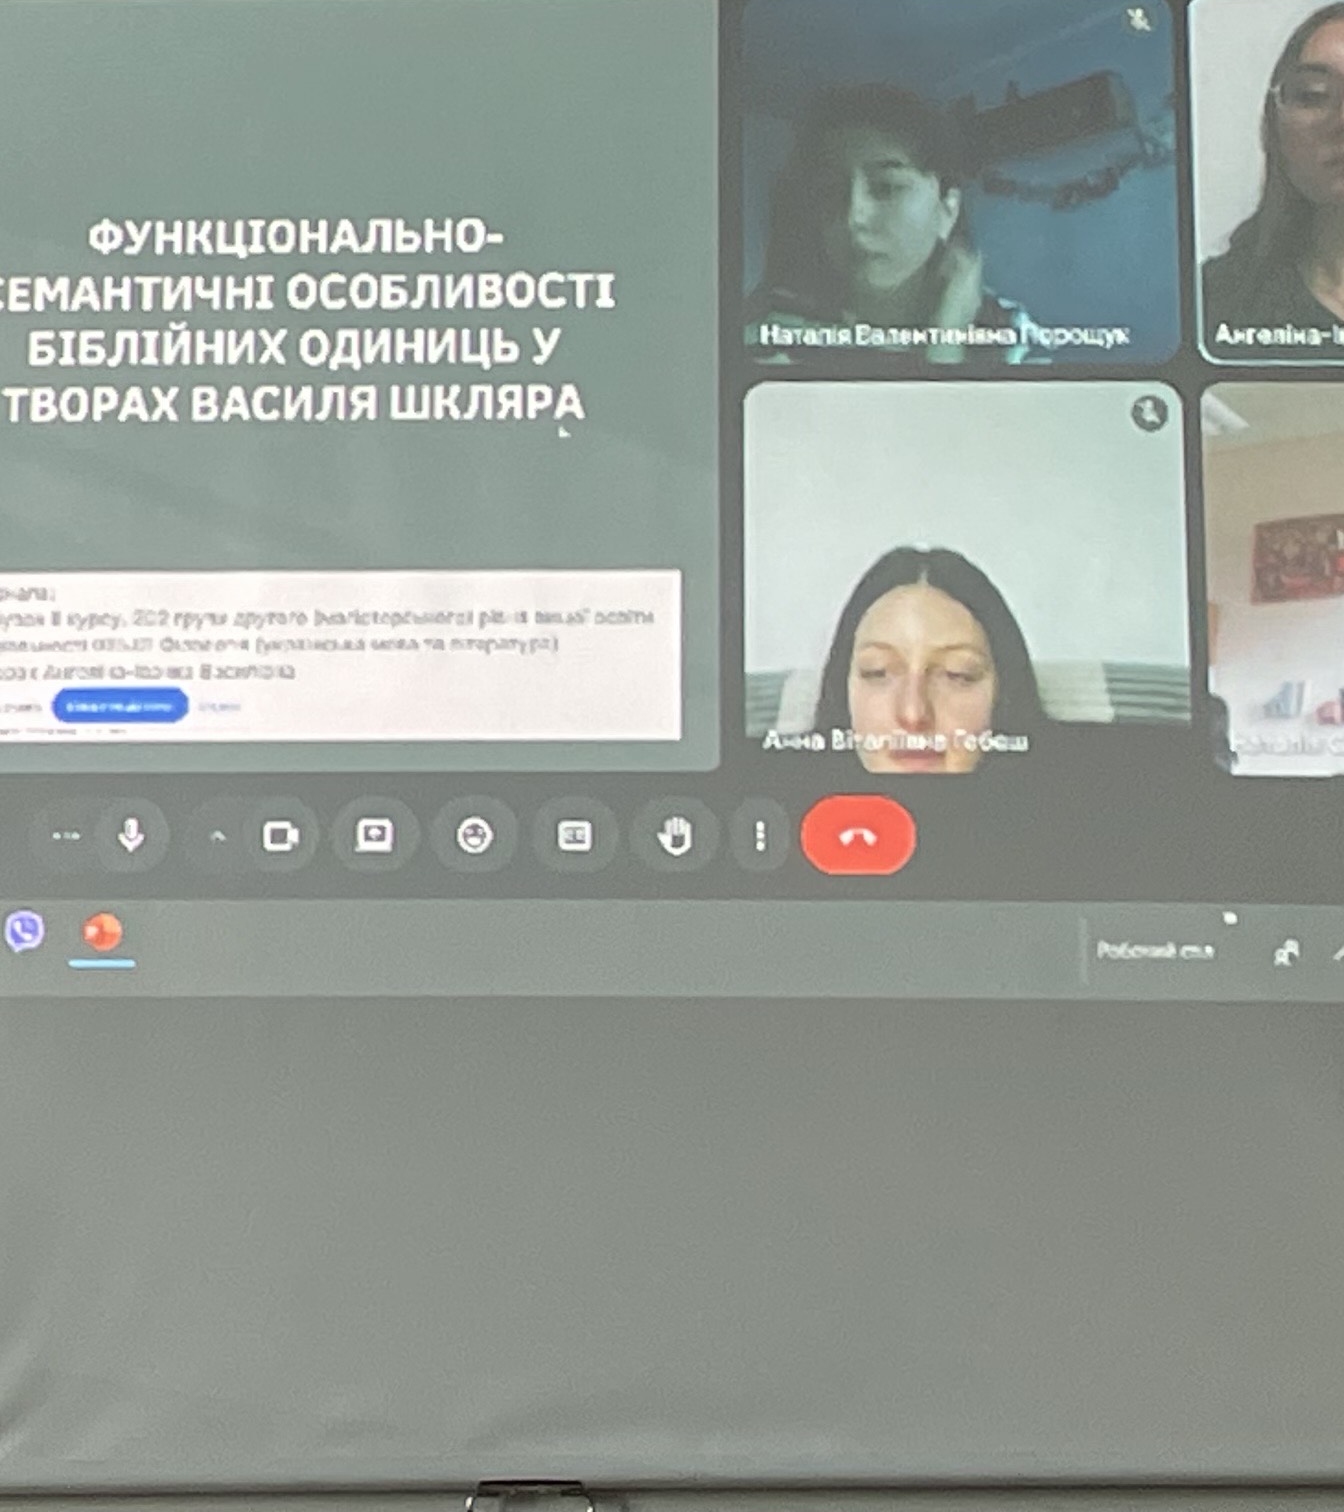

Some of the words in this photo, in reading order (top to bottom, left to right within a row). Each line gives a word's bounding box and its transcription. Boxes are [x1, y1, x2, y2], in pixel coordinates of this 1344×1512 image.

[88, 218, 504, 258] ФУНКЦІОНАЛЬНО-
[287, 272, 616, 311] ОСОБЛИВОСТІ
[27, 321, 288, 368] БІБЛІЙНИХ
[299, 326, 519, 370] ОДИНИЦЬ
[532, 326, 562, 365] У
[759, 323, 852, 347] Наталія
[2, 385, 179, 423] ТВОРАХ
[191, 384, 377, 422] ВАСИЛЯ
[390, 383, 586, 421] ШКЛЯРА
[761, 728, 826, 753] Анна
